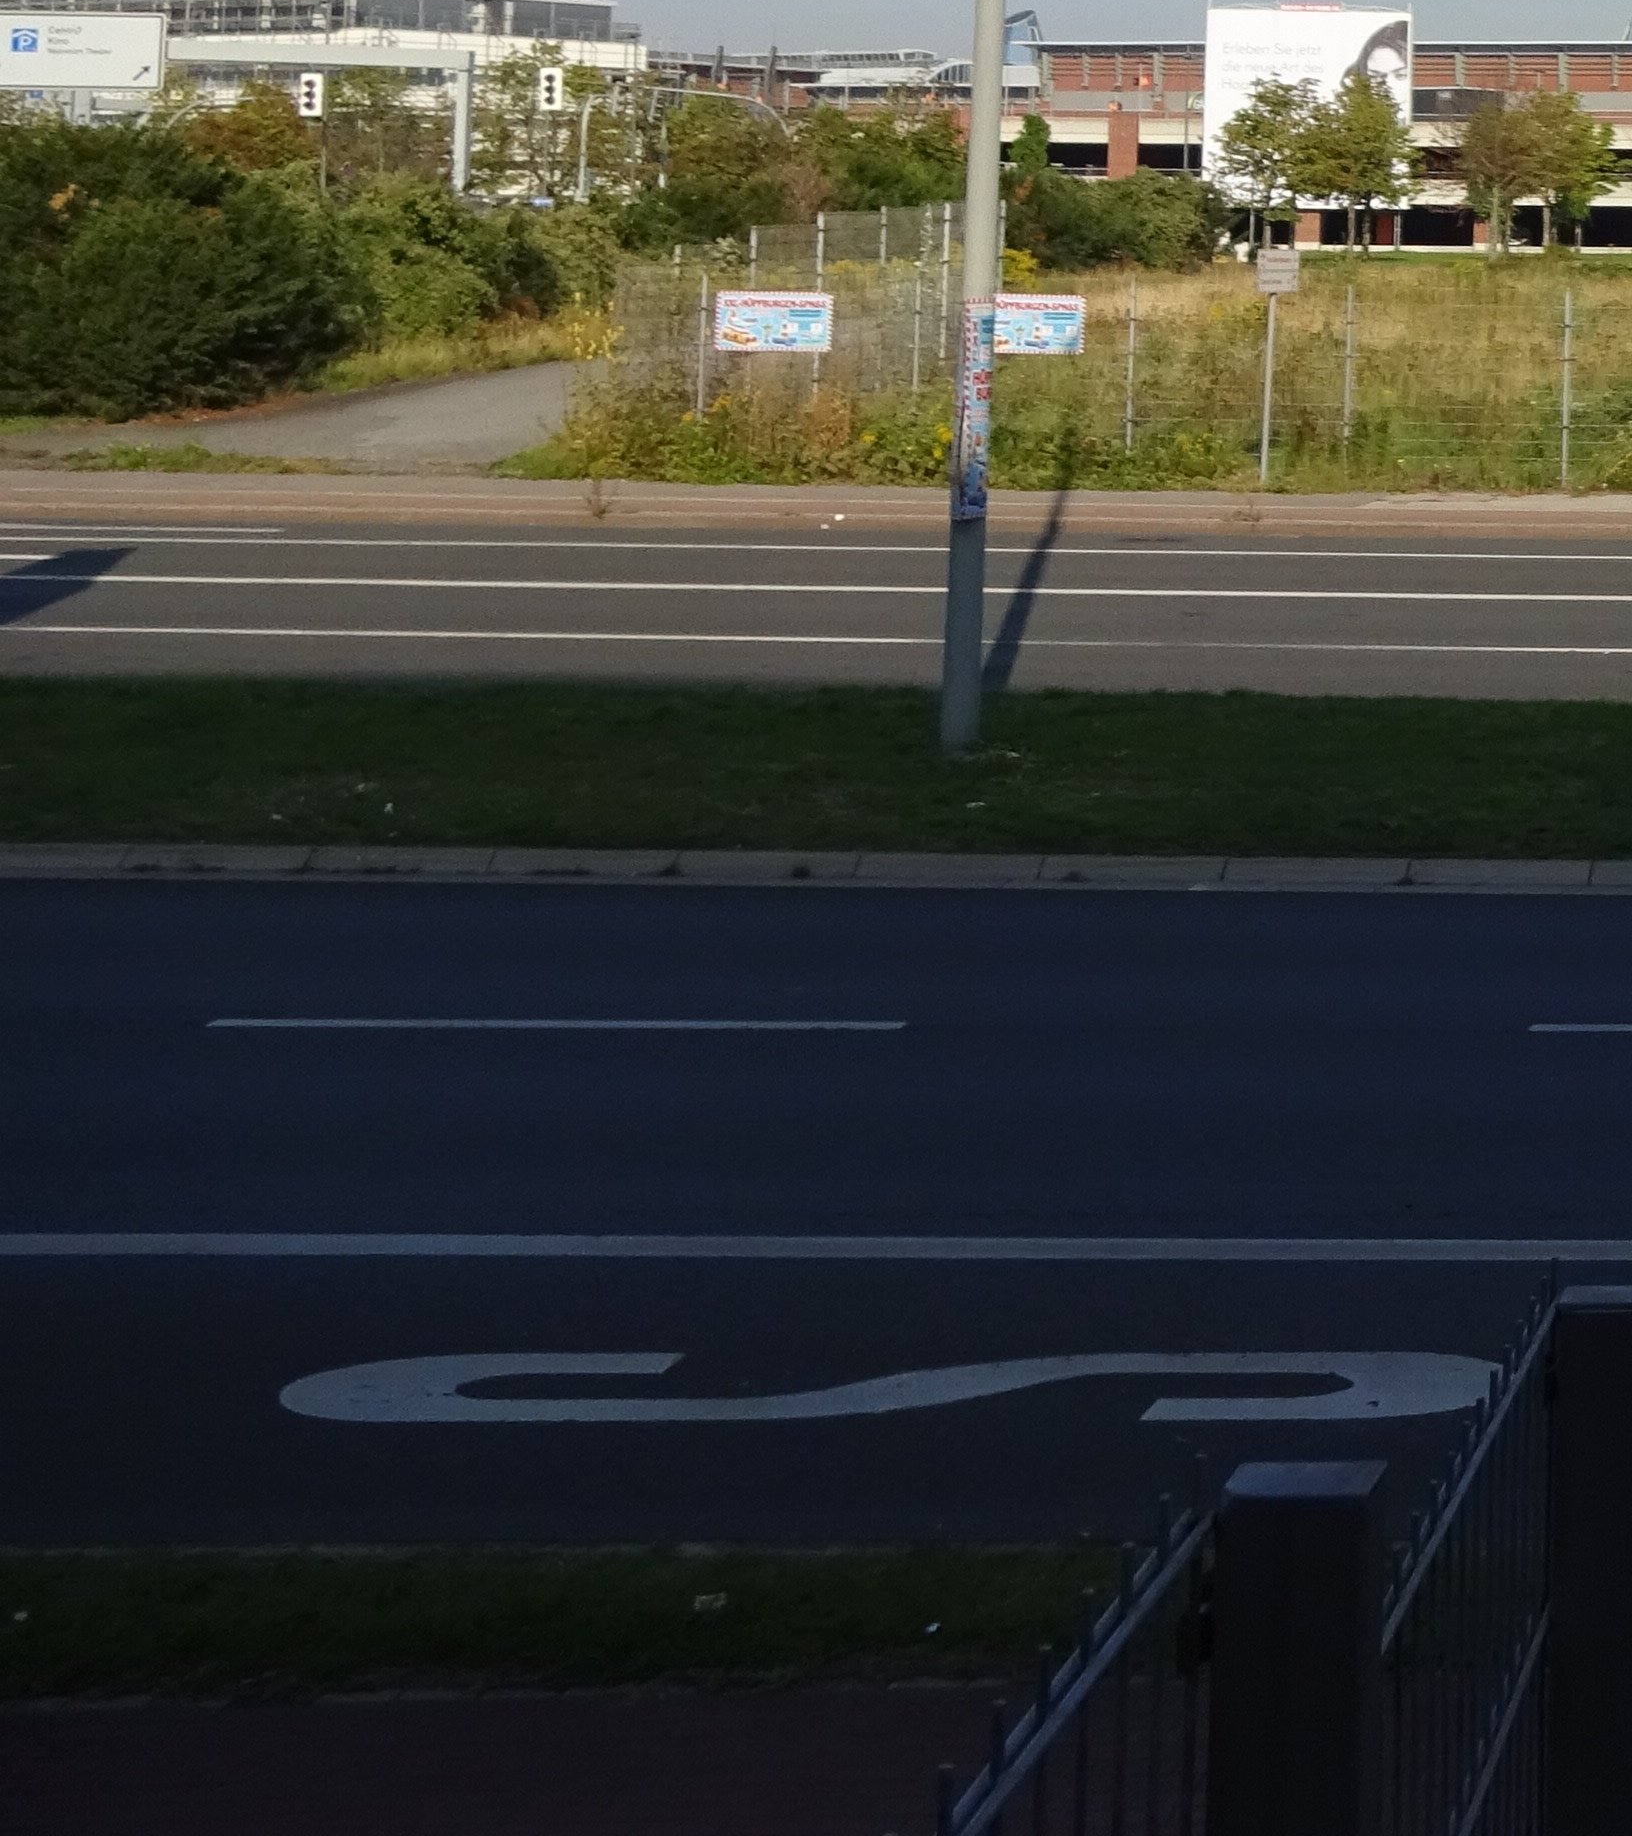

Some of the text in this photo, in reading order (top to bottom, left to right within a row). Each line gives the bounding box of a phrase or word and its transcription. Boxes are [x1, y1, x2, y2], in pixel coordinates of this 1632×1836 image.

[1222, 43, 1270, 55] Erleben
[1274, 43, 1292, 55] Sie
[1222, 61, 1241, 72] die
